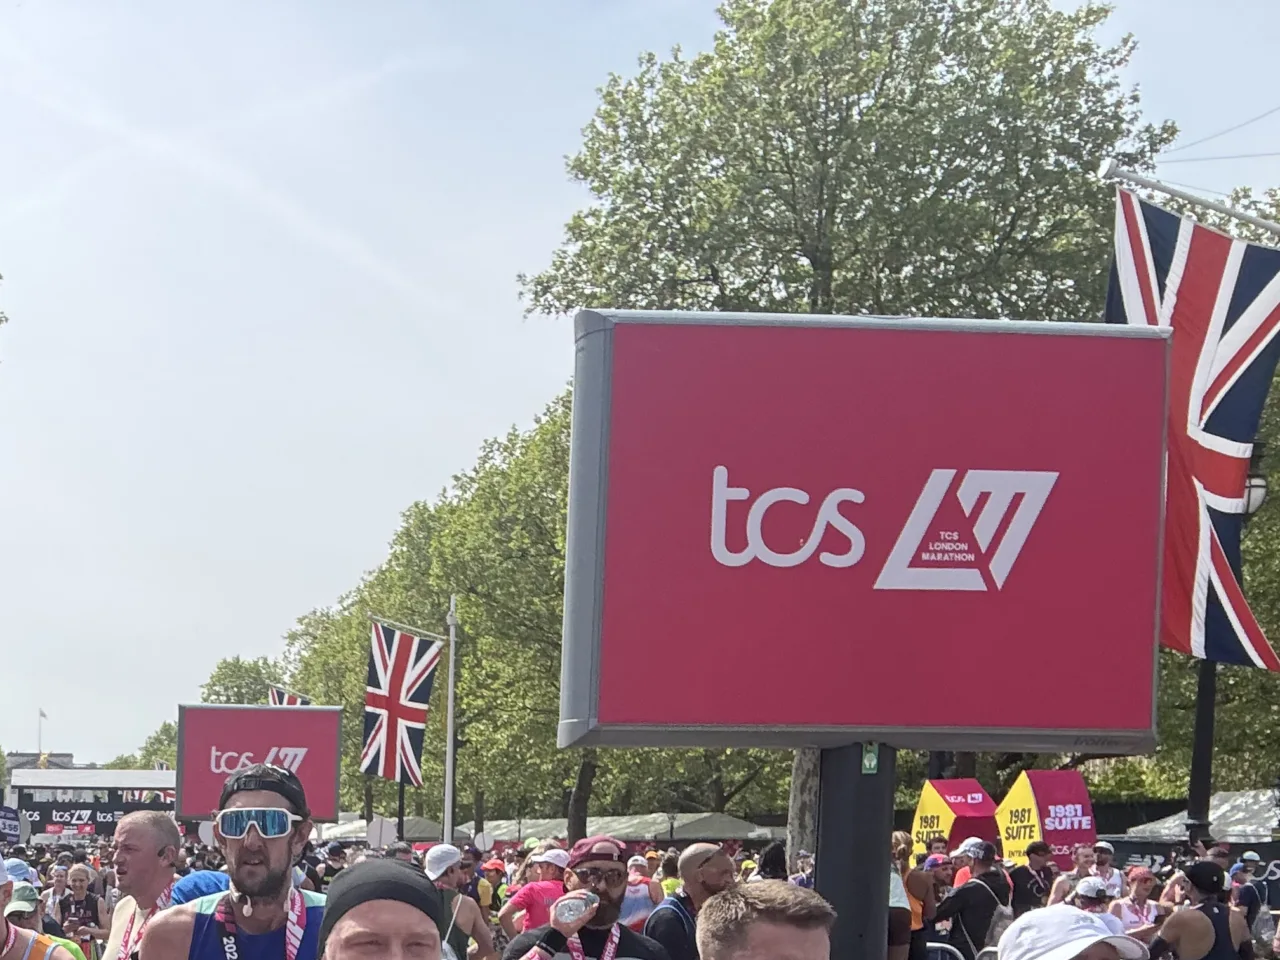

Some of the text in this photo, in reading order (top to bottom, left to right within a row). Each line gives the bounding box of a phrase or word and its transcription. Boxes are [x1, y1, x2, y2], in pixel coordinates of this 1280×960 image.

[710, 465, 866, 568] tcs
[939, 530, 960, 541] TCS
[928, 542, 969, 552] LONDON
[921, 552, 975, 563] MARATHON
[210, 745, 255, 775] tcs
[52, 809, 71, 822] tcs
[96, 810, 114, 822] tcs
[1010, 807, 1032, 824] 1981
[1047, 804, 1083, 818] 1981
[919, 814, 940, 829] 1981
[1044, 816, 1092, 831] SUITE
[1004, 824, 1036, 841] SUITE
